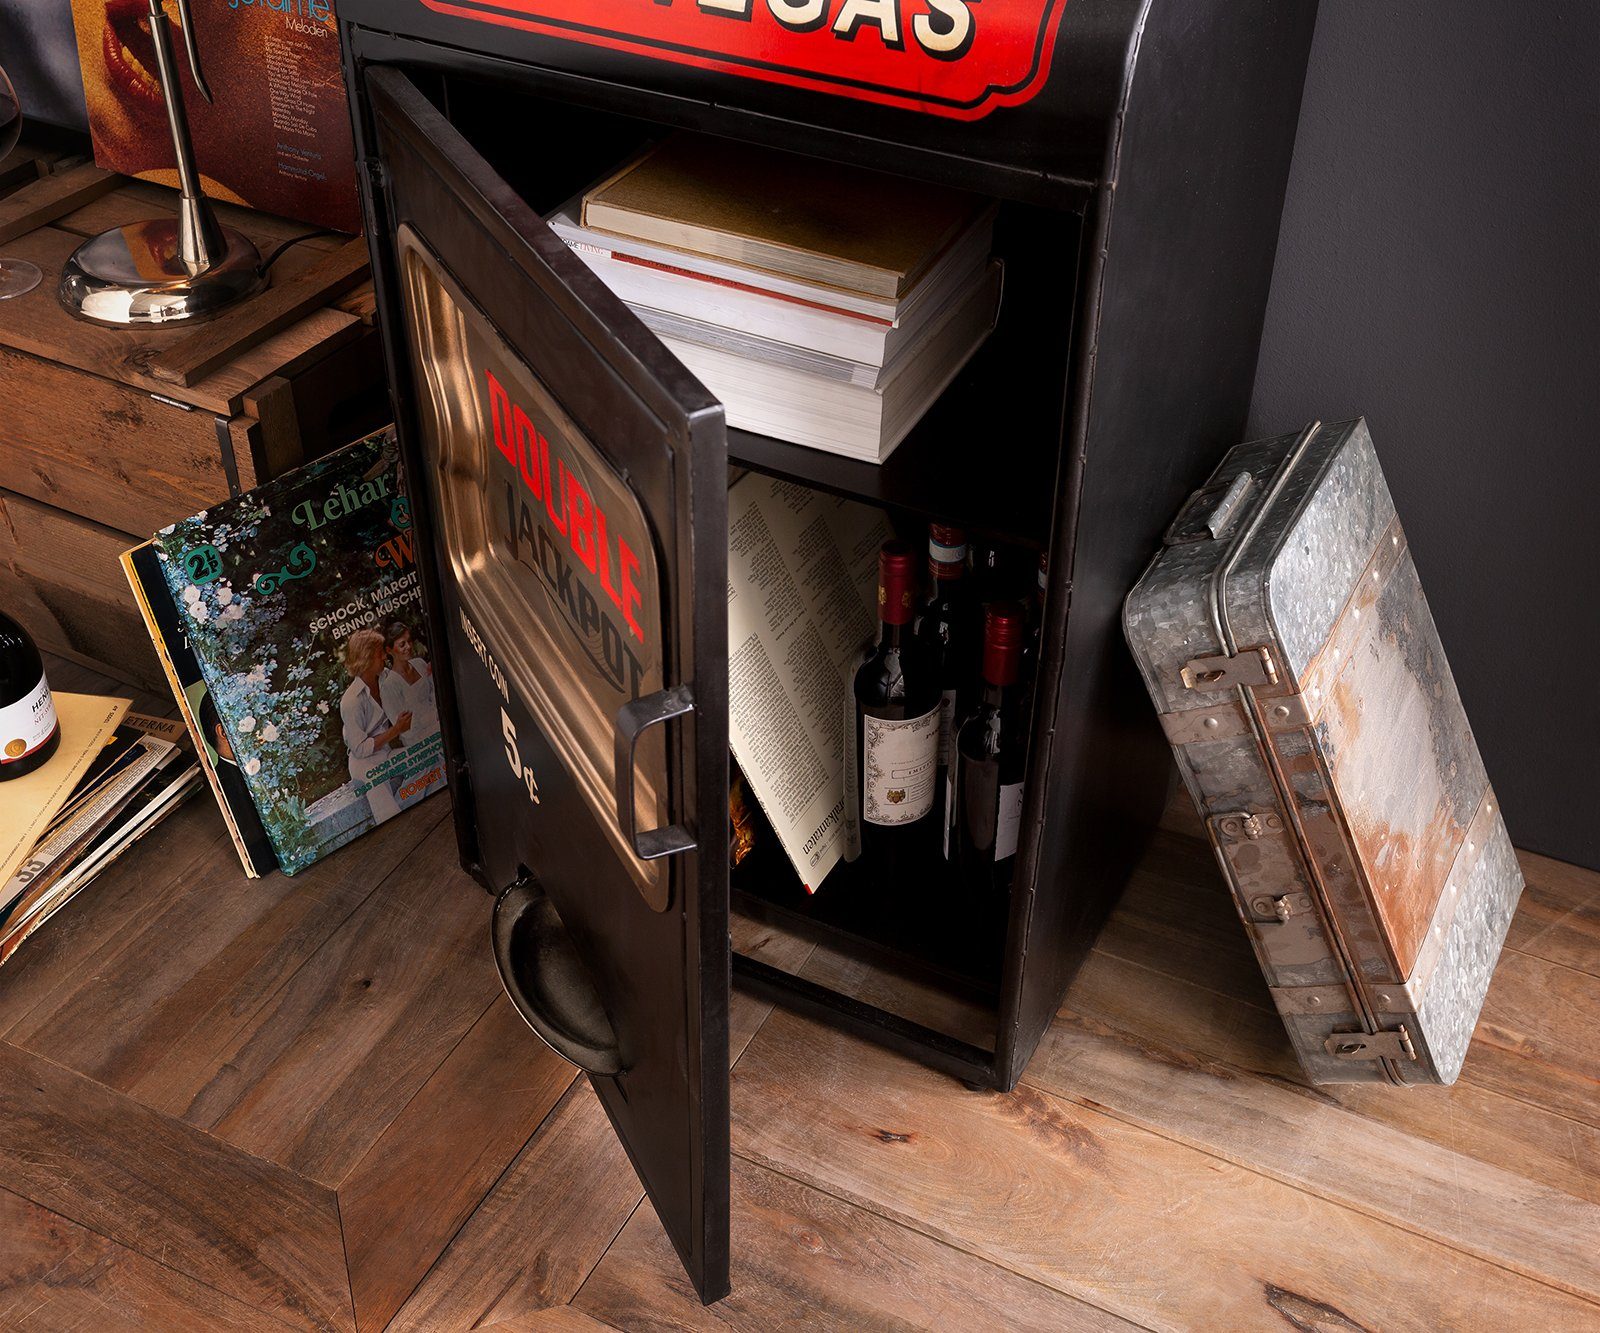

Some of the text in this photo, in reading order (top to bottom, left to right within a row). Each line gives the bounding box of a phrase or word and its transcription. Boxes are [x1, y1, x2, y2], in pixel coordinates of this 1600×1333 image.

[285, 16, 328, 38] Melodien
[291, 474, 389, 531] Lehar
[485, 369, 644, 643] DOUBLE
[370, 571, 418, 604] MARGIT
[504, 478, 645, 700] JACKPOT
[332, 611, 374, 640] BENNO
[459, 606, 510, 705] INSERT COIN
[124, 715, 176, 734] ETERNA
[366, 760, 391, 779] CHOR
[391, 751, 407, 766] DER
[407, 741, 443, 767] SYMPHO
[399, 767, 442, 801] ROBERT
[802, 796, 845, 855] ralkantaten
